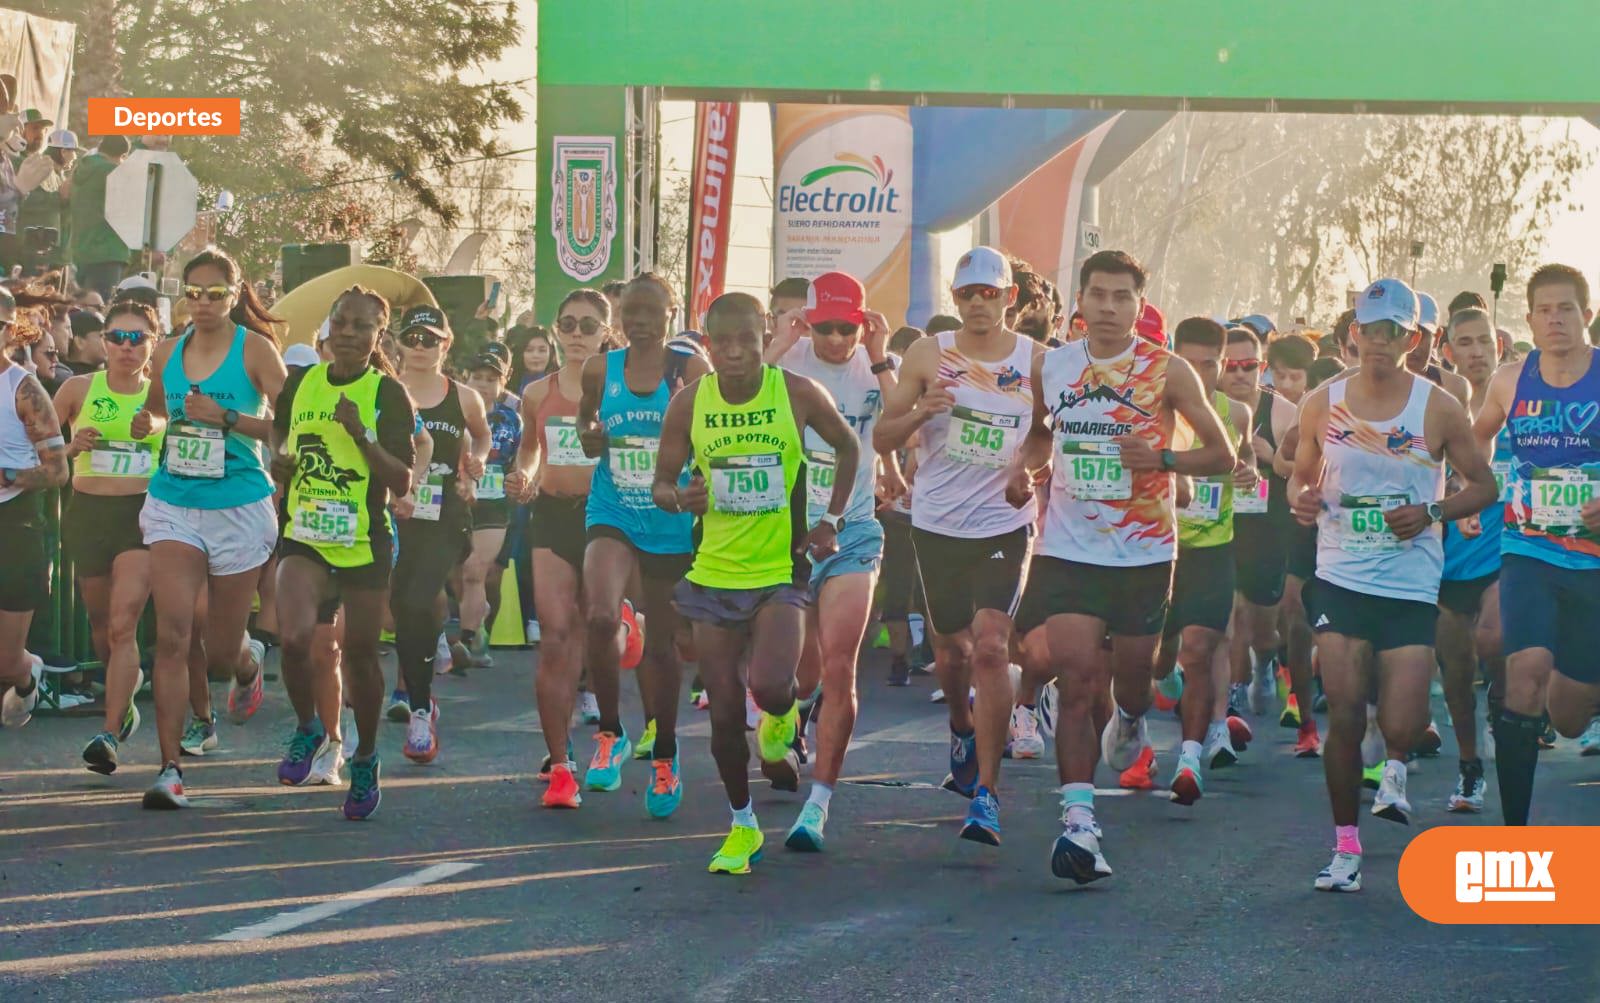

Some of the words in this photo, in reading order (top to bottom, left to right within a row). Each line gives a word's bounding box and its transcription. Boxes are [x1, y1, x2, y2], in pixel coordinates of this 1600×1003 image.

[699, 100, 731, 294] alimax
[779, 185, 899, 213] Electrolit
[704, 408, 777, 428] KIBET
[703, 436, 732, 457] CLUB
[736, 433, 788, 451] POTROS
[960, 422, 1005, 451] 543
[1516, 435, 1560, 447] RUNNING
[1564, 436, 1591, 448] TEAM
[178, 438, 211, 460] 927
[111, 453, 132, 473] 77
[1072, 457, 1122, 481] 1575
[723, 469, 769, 494] 750
[1538, 484, 1593, 507] 1208
[300, 511, 349, 536] 1355
